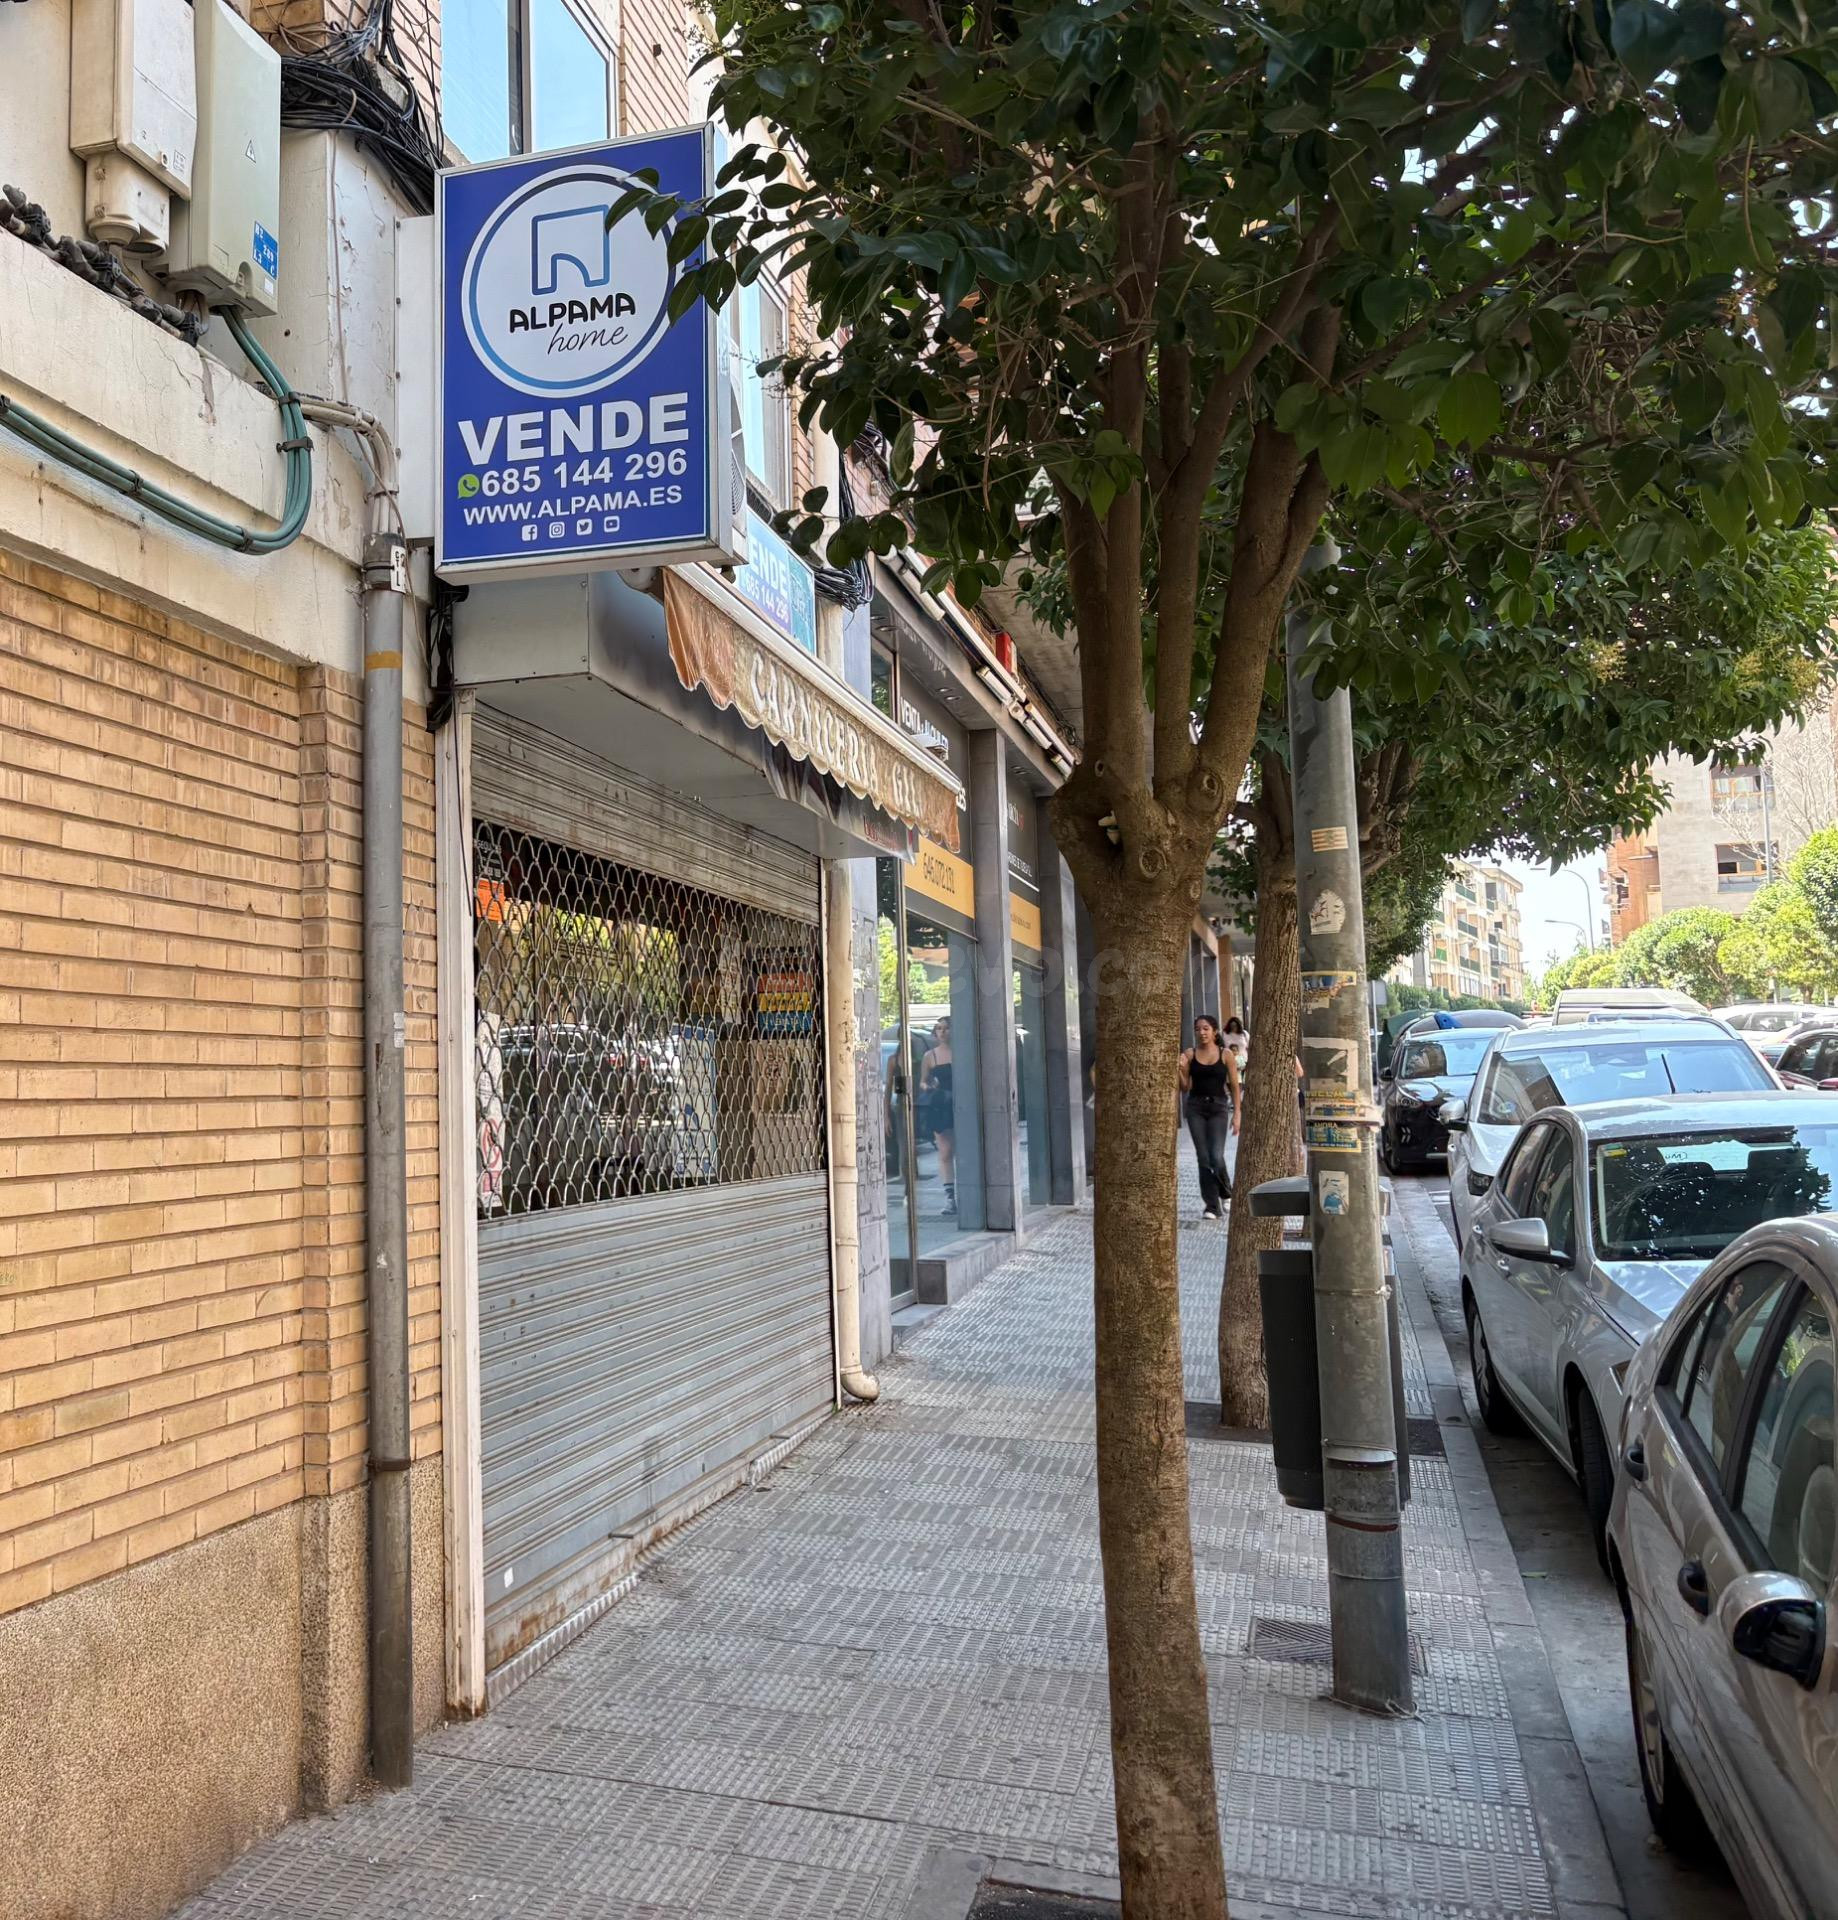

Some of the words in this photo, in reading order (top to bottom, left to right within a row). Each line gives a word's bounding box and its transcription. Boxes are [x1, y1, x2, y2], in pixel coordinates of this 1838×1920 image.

[509, 291, 637, 334] ALPAMA
[547, 322, 629, 355] home
[457, 392, 690, 467] VENDE
[481, 470, 541, 498] 685
[553, 458, 614, 487] 144
[624, 448, 688, 481] 296
[463, 484, 683, 527] WWW.ALPAMA.ES
[747, 534, 789, 600] ENDE
